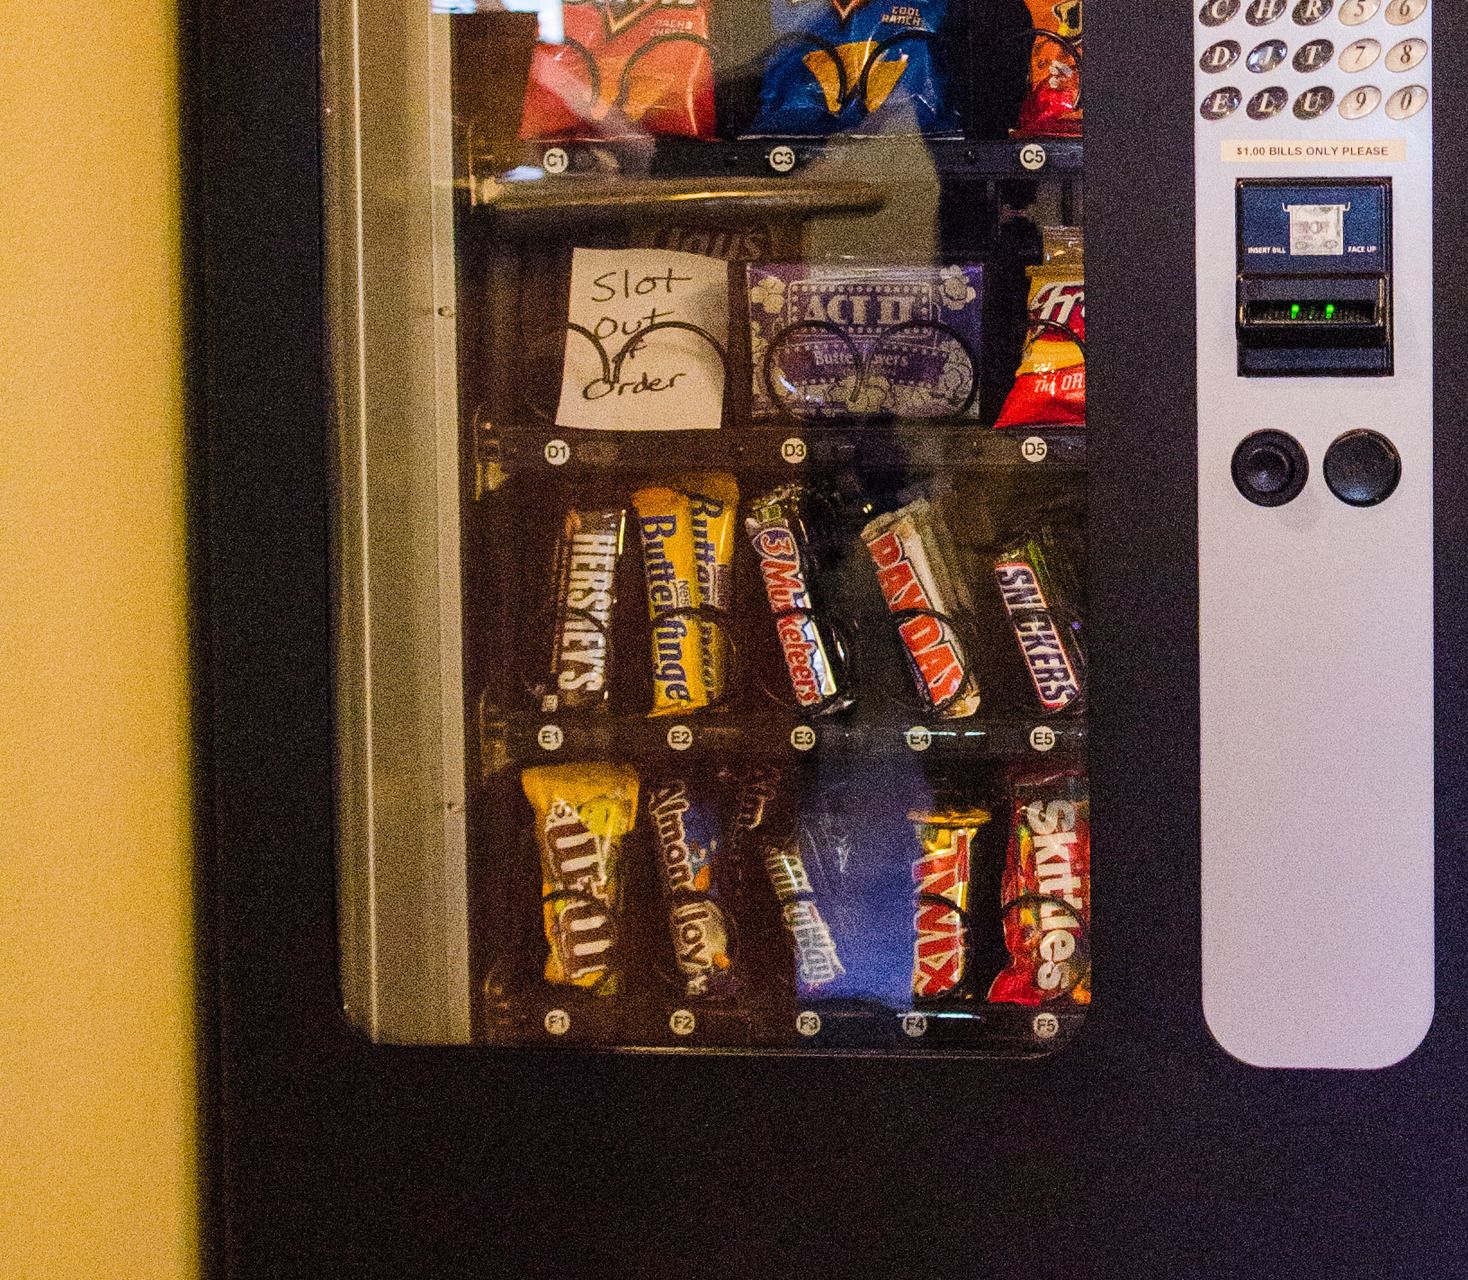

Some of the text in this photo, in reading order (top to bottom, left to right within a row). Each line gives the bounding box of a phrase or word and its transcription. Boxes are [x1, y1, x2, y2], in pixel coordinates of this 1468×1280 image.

[892, 7, 920, 17] COOL
[1211, 0, 1229, 19] C
[1256, 0, 1275, 18] H
[1306, 0, 1321, 18] R
[1354, 0, 1365, 17] 5
[882, 14, 922, 27] RANCH
[1213, 45, 1412, 65] D J T 7 8
[1213, 94, 1229, 112] E
[1260, 94, 1272, 112] L
[1306, 92, 1322, 111] U
[1356, 92, 1366, 111] 9
[772, 151, 793, 164] C3
[1023, 151, 1044, 163] C5
[1236, 146, 1389, 157] $1.00 BILLS ONLY PLEASE
[1273, 246, 1286, 254] BILL
[591, 268, 693, 302] Slot
[804, 295, 869, 325] ACT
[812, 350, 855, 366] Butte
[547, 445, 567, 459] D1
[784, 443, 805, 456] D3
[1024, 442, 1046, 456] D5
[760, 530, 795, 557] 3
[557, 534, 617, 692] HERSHEY'S
[640, 514, 691, 703] Butterfinge
[999, 568, 1080, 705] SNICKERS
[541, 731, 560, 743] E1
[671, 731, 690, 743] E2
[794, 732, 814, 744] E3
[910, 732, 929, 745] E4
[1033, 732, 1053, 744] E5
[650, 780, 713, 971] Almon Joy
[766, 849, 816, 927] Mily
[1025, 799, 1084, 991] Skittles
[674, 1016, 693, 1029] F2
[800, 1018, 818, 1030] F3
[906, 1018, 924, 1030] F4
[1037, 1018, 1056, 1031] F5
